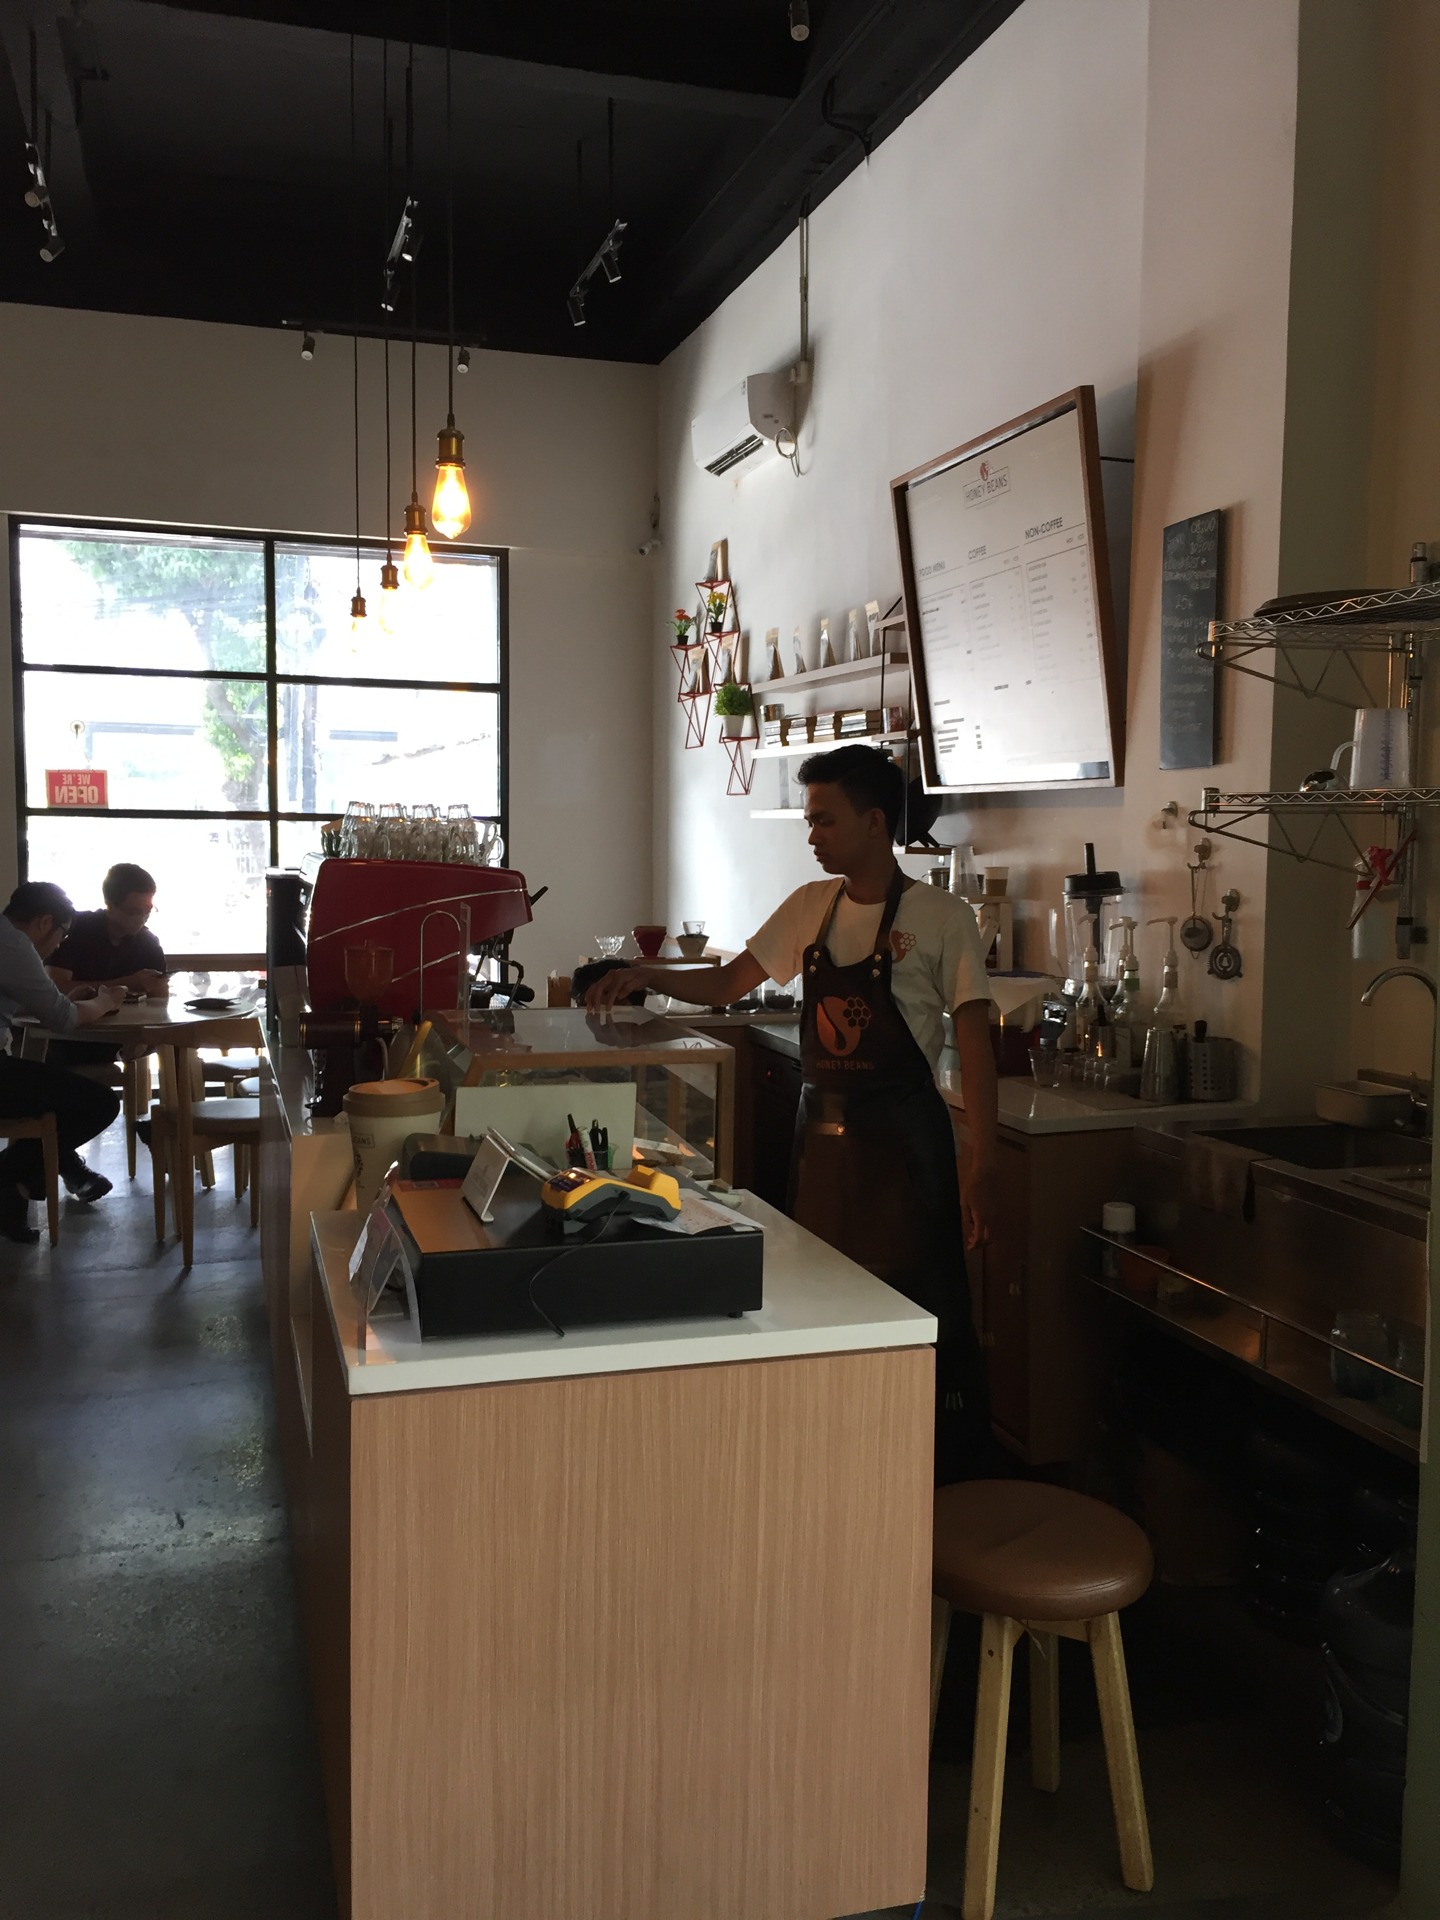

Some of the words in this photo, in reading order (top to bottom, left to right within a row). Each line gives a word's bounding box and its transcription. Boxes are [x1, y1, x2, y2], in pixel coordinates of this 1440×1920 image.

[965, 486, 986, 501] HONEY
[986, 474, 1008, 494] BEANS
[1025, 517, 1063, 539] NON-COFFEE
[967, 545, 987, 560] COFFEE
